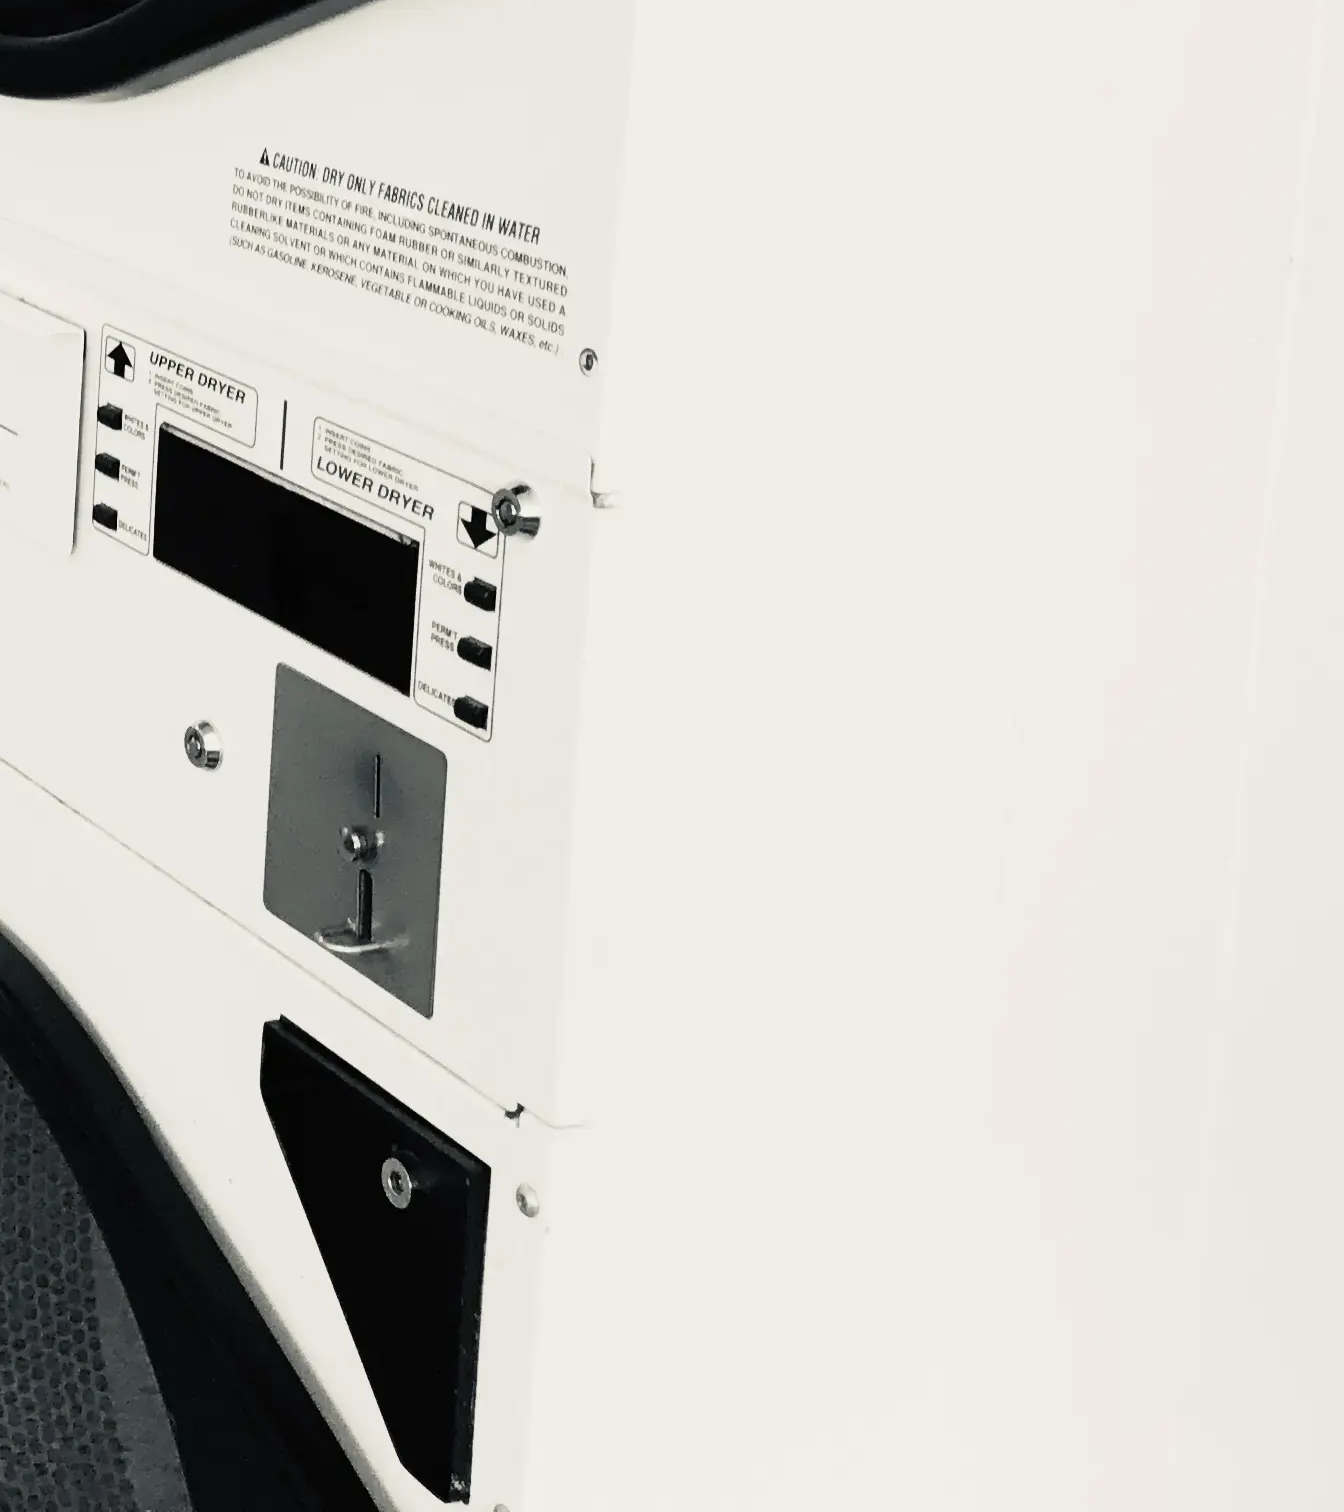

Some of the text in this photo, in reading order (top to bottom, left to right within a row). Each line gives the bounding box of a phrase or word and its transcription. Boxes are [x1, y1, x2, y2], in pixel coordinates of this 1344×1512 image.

[232, 184, 568, 298] DO NOT DRY ITEMS CONTAINING FOAM RUBBER OR SIMILARLY TEXTURED
[234, 167, 245, 180] TO
[246, 171, 271, 187] AVOID
[273, 179, 287, 193] THE
[290, 184, 340, 208] POSSIBILITY
[341, 200, 353, 211] OF
[378, 211, 425, 234] INCLUDING
[428, 225, 499, 256] SPONTANEOUS
[322, 166, 345, 187] DRY
[346, 173, 376, 196] ONLY
[378, 182, 425, 212] FABRICS
[427, 196, 480, 227] CLEANED
[482, 212, 495, 232] IN
[498, 216, 541, 245] WATER
[229, 236, 253, 252] (SUCH
[255, 244, 266, 256] AS
[361, 279, 411, 304] VEGETABLE
[414, 296, 427, 309] OR
[429, 301, 472, 325] COOKING
[230, 217, 565, 337] CLEANING SOLVENT OR WHICH CONTAINS FLAMMABLE LIQUIDS OR SOLIDS
[231, 201, 566, 317] RUBBERLIKE MATERIALS OR ANY MATERIAL ON WHICH YOU HAVE USED A
[149, 351, 246, 404] UPPER DRYER
[316, 455, 434, 521] LOWER DRYER
[430, 632, 454, 652] PRESS
